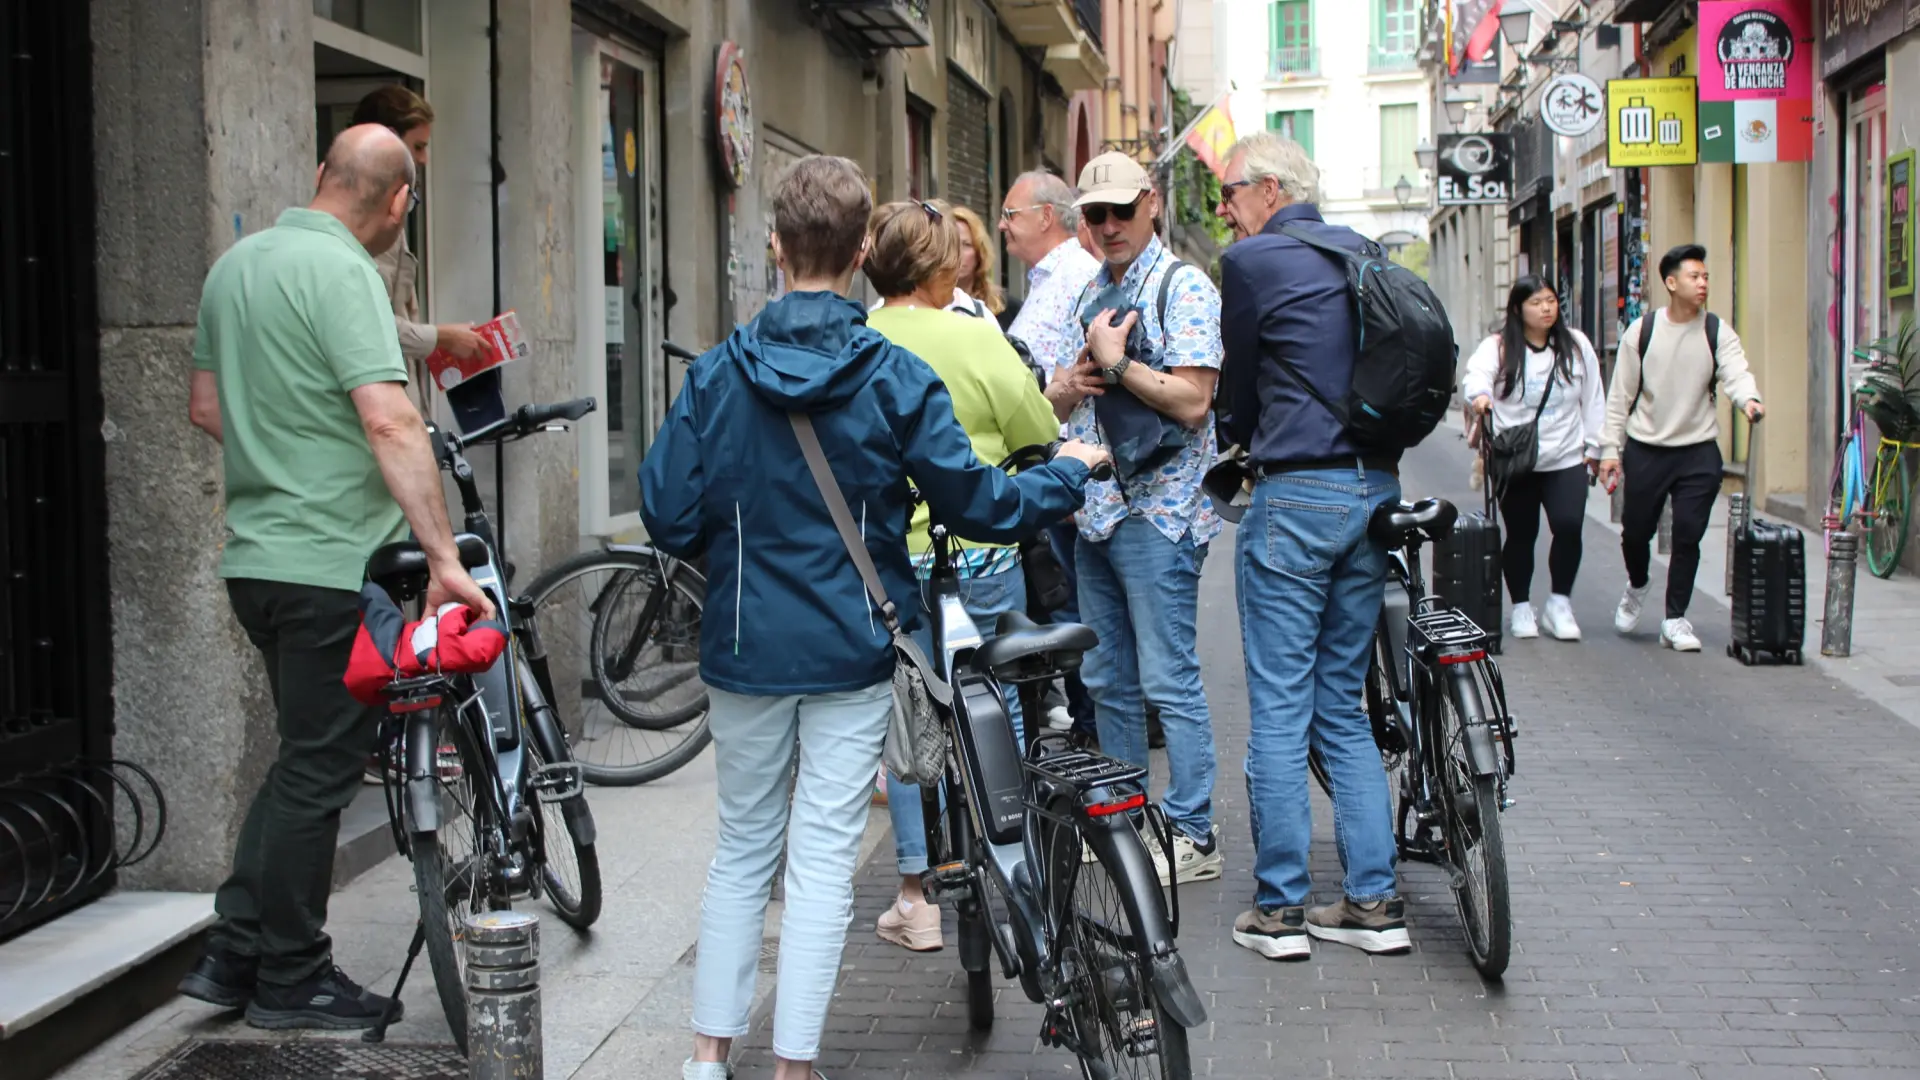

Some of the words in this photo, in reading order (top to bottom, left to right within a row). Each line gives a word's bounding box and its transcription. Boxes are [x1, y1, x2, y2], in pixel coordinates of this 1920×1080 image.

[1724, 62, 1736, 76] LA
[1737, 61, 1785, 76] VENGANZA
[1724, 76, 1736, 90] DE
[1738, 75, 1785, 89] MALINCHE
[1438, 175, 1464, 199] EL
